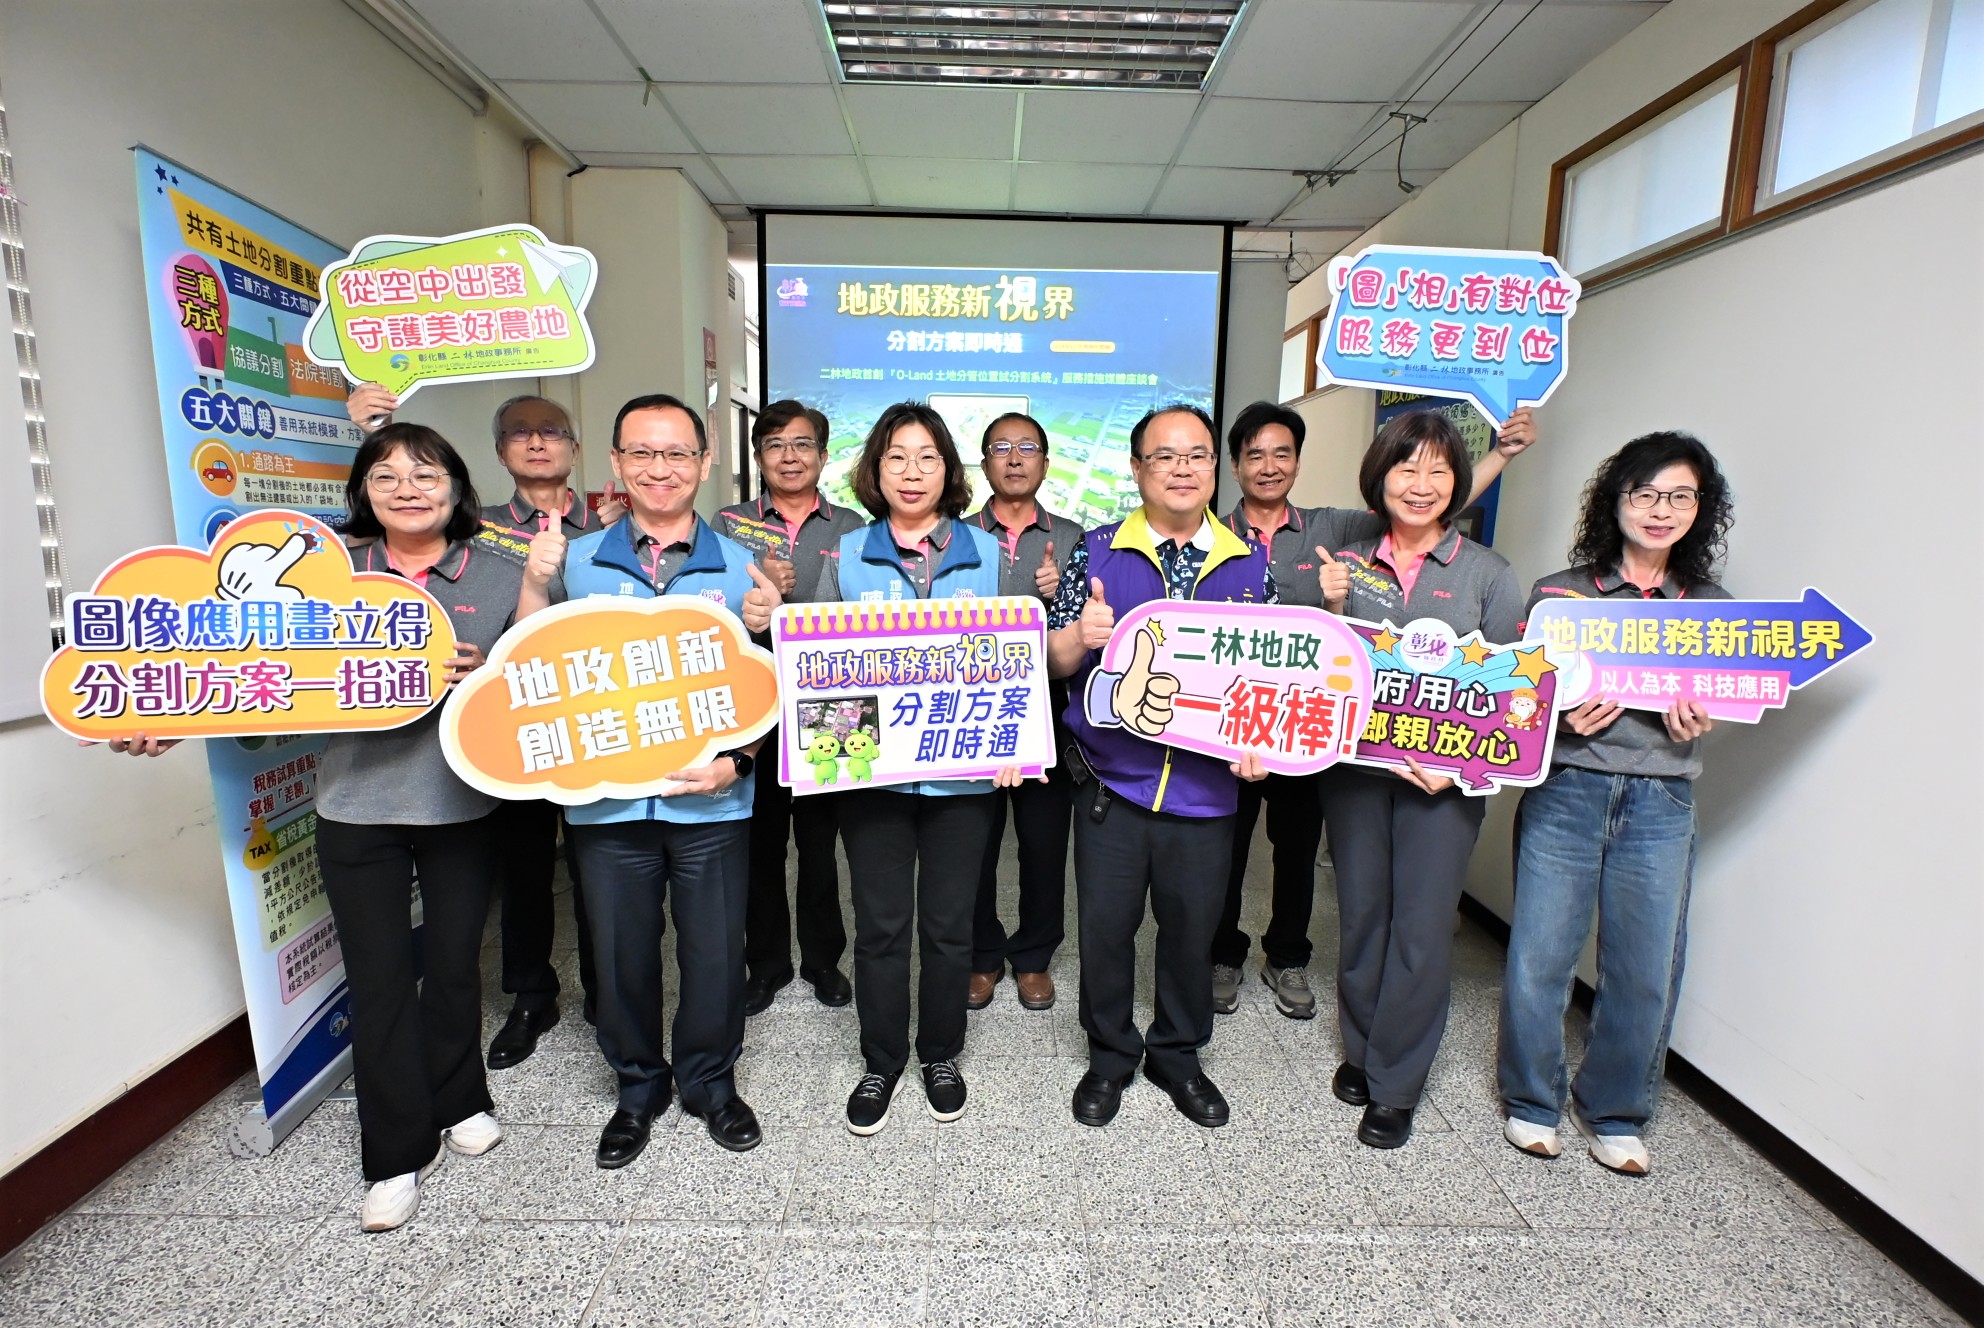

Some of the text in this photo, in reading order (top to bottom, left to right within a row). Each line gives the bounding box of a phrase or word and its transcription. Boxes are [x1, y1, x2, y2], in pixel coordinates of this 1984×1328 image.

[186, 209, 320, 293] 共有土地分割重點
[174, 264, 219, 305] 三種
[338, 263, 526, 307] 從空中出發
[837, 274, 1075, 323] 地政服務新視界
[1337, 266, 1572, 312] 「圖」「相」有對位
[179, 299, 223, 336] 方式
[348, 306, 569, 351] 守護美好農地
[1338, 317, 1557, 359] 服務更到位
[229, 344, 284, 379] 協議分割
[417, 352, 447, 362] 彰化縣
[475, 346, 522, 358] 地政事務所
[886, 330, 1023, 355] 分割方案即時通
[819, 368, 884, 381] 二林地政首創
[1404, 363, 1428, 372] 彰化縣
[1451, 366, 1490, 376] 地政事務所
[188, 394, 274, 436] 五大關鍵
[251, 452, 296, 474] 通路為王
[1297, 563, 1313, 571] FILA
[72, 597, 431, 649] 圖像應用畫立得
[454, 605, 477, 613] FILA
[1172, 625, 1322, 672] 二林地政
[1540, 615, 1845, 661] 地政服務新視界
[502, 625, 727, 711] 地政創新
[796, 632, 1034, 690] 地政服務新視界
[73, 659, 433, 714] 分割方案一指通
[888, 685, 1032, 728] 分割方案
[1374, 668, 1499, 718] 府用心
[1599, 671, 1781, 701] 以人為本 科技應用
[515, 684, 740, 774] 創造無限
[1172, 679, 1359, 757] 一級棒！
[914, 722, 1020, 763] 即時通
[248, 773, 317, 819] 掌握「差額」
[248, 840, 273, 860] TAX
